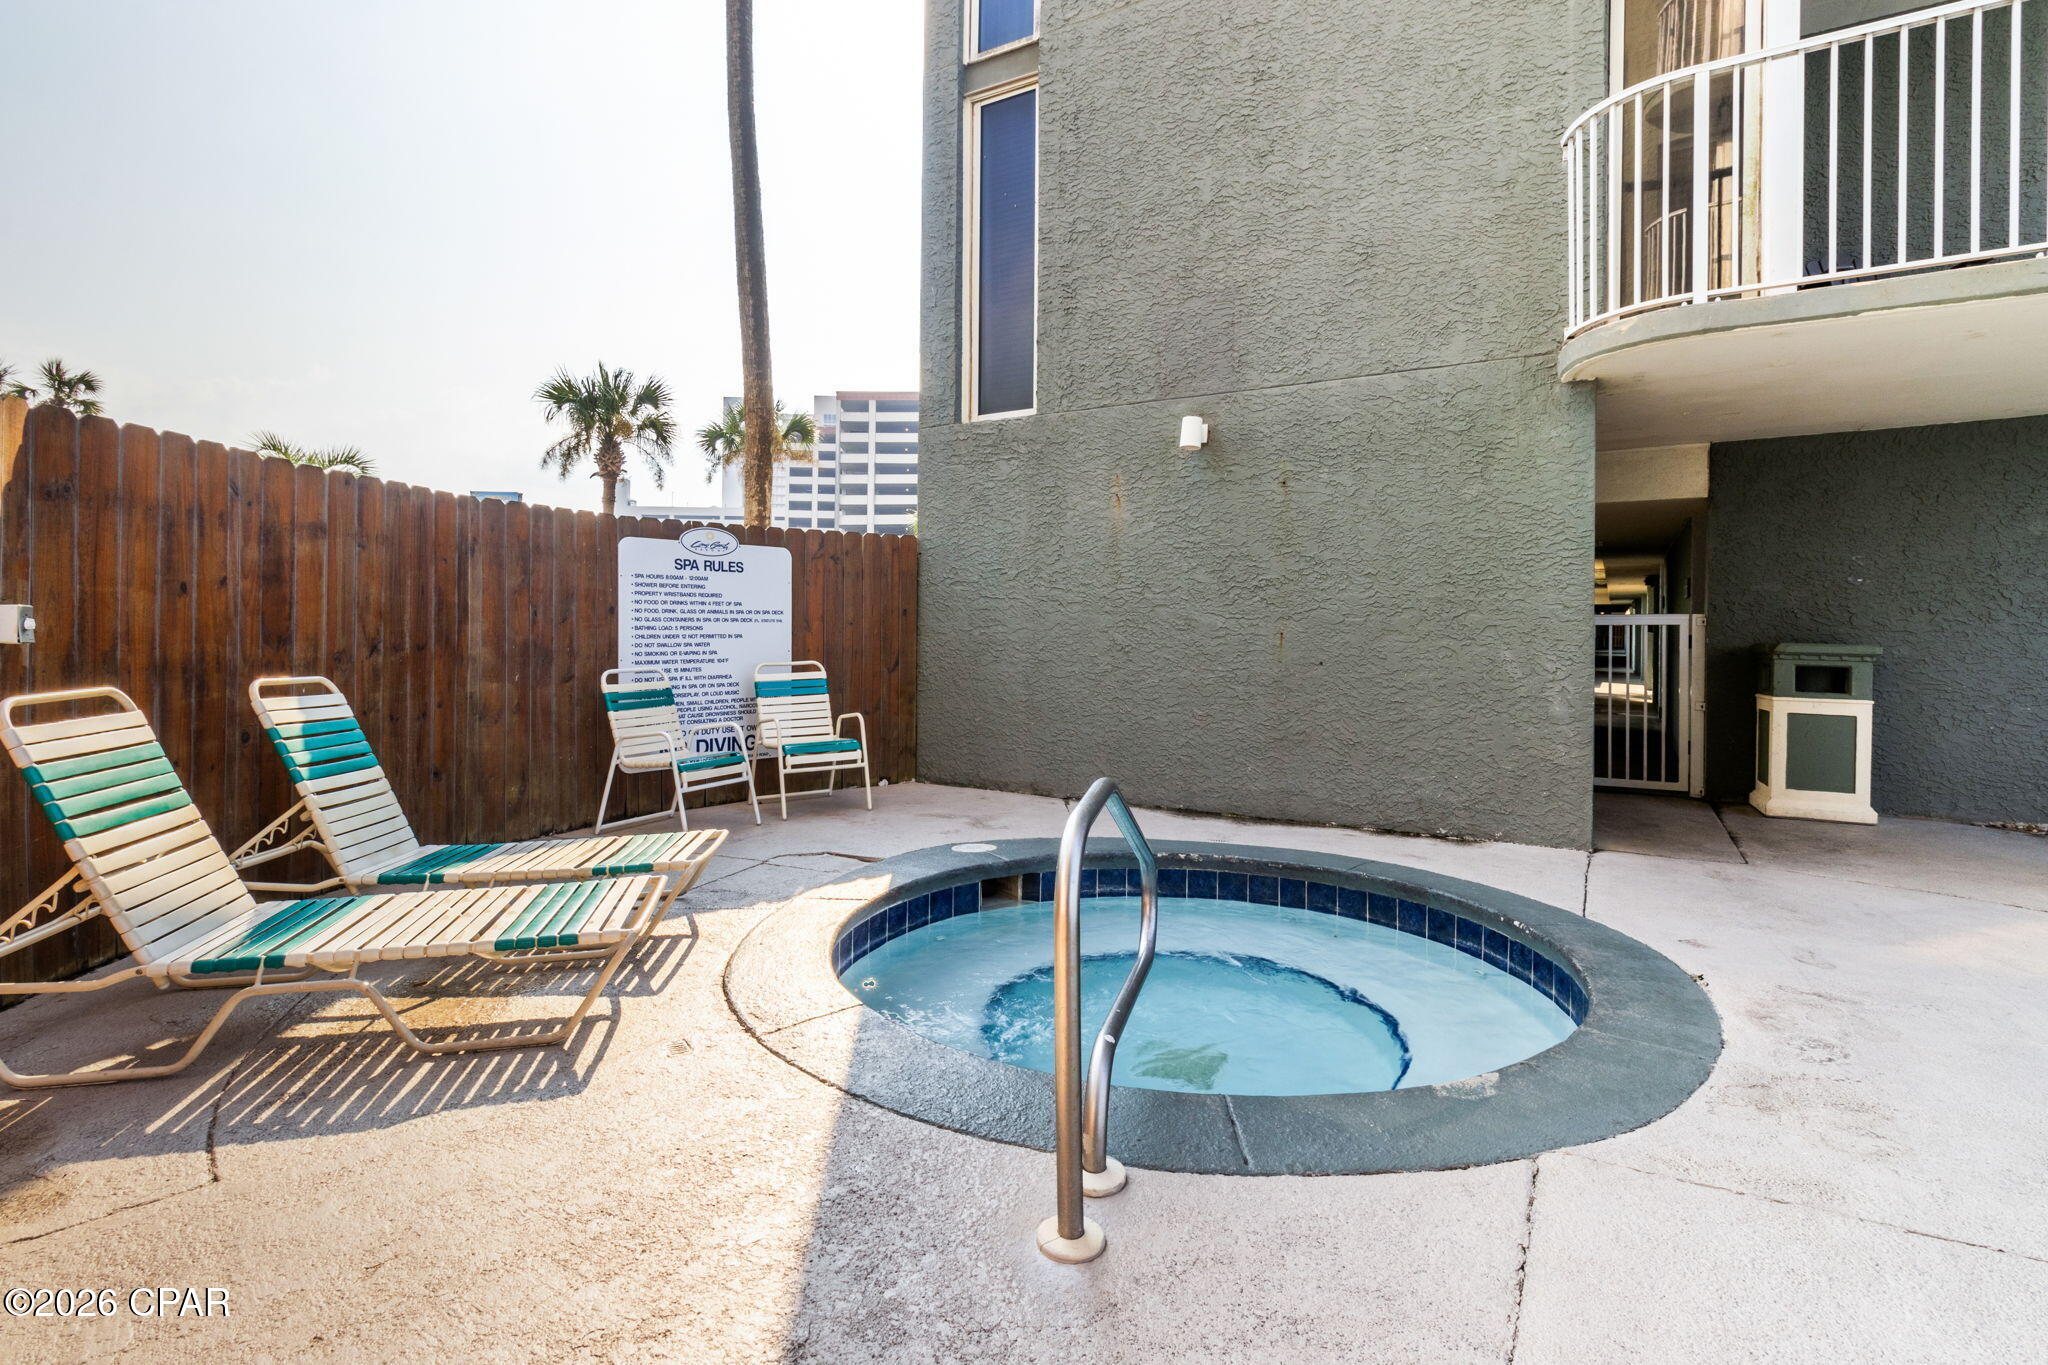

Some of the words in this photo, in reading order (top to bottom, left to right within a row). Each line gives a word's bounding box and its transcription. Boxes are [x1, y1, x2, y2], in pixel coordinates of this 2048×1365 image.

[674, 558, 699, 571] SPA
[704, 560, 744, 573] RULES
[696, 734, 756, 752] DIVING
